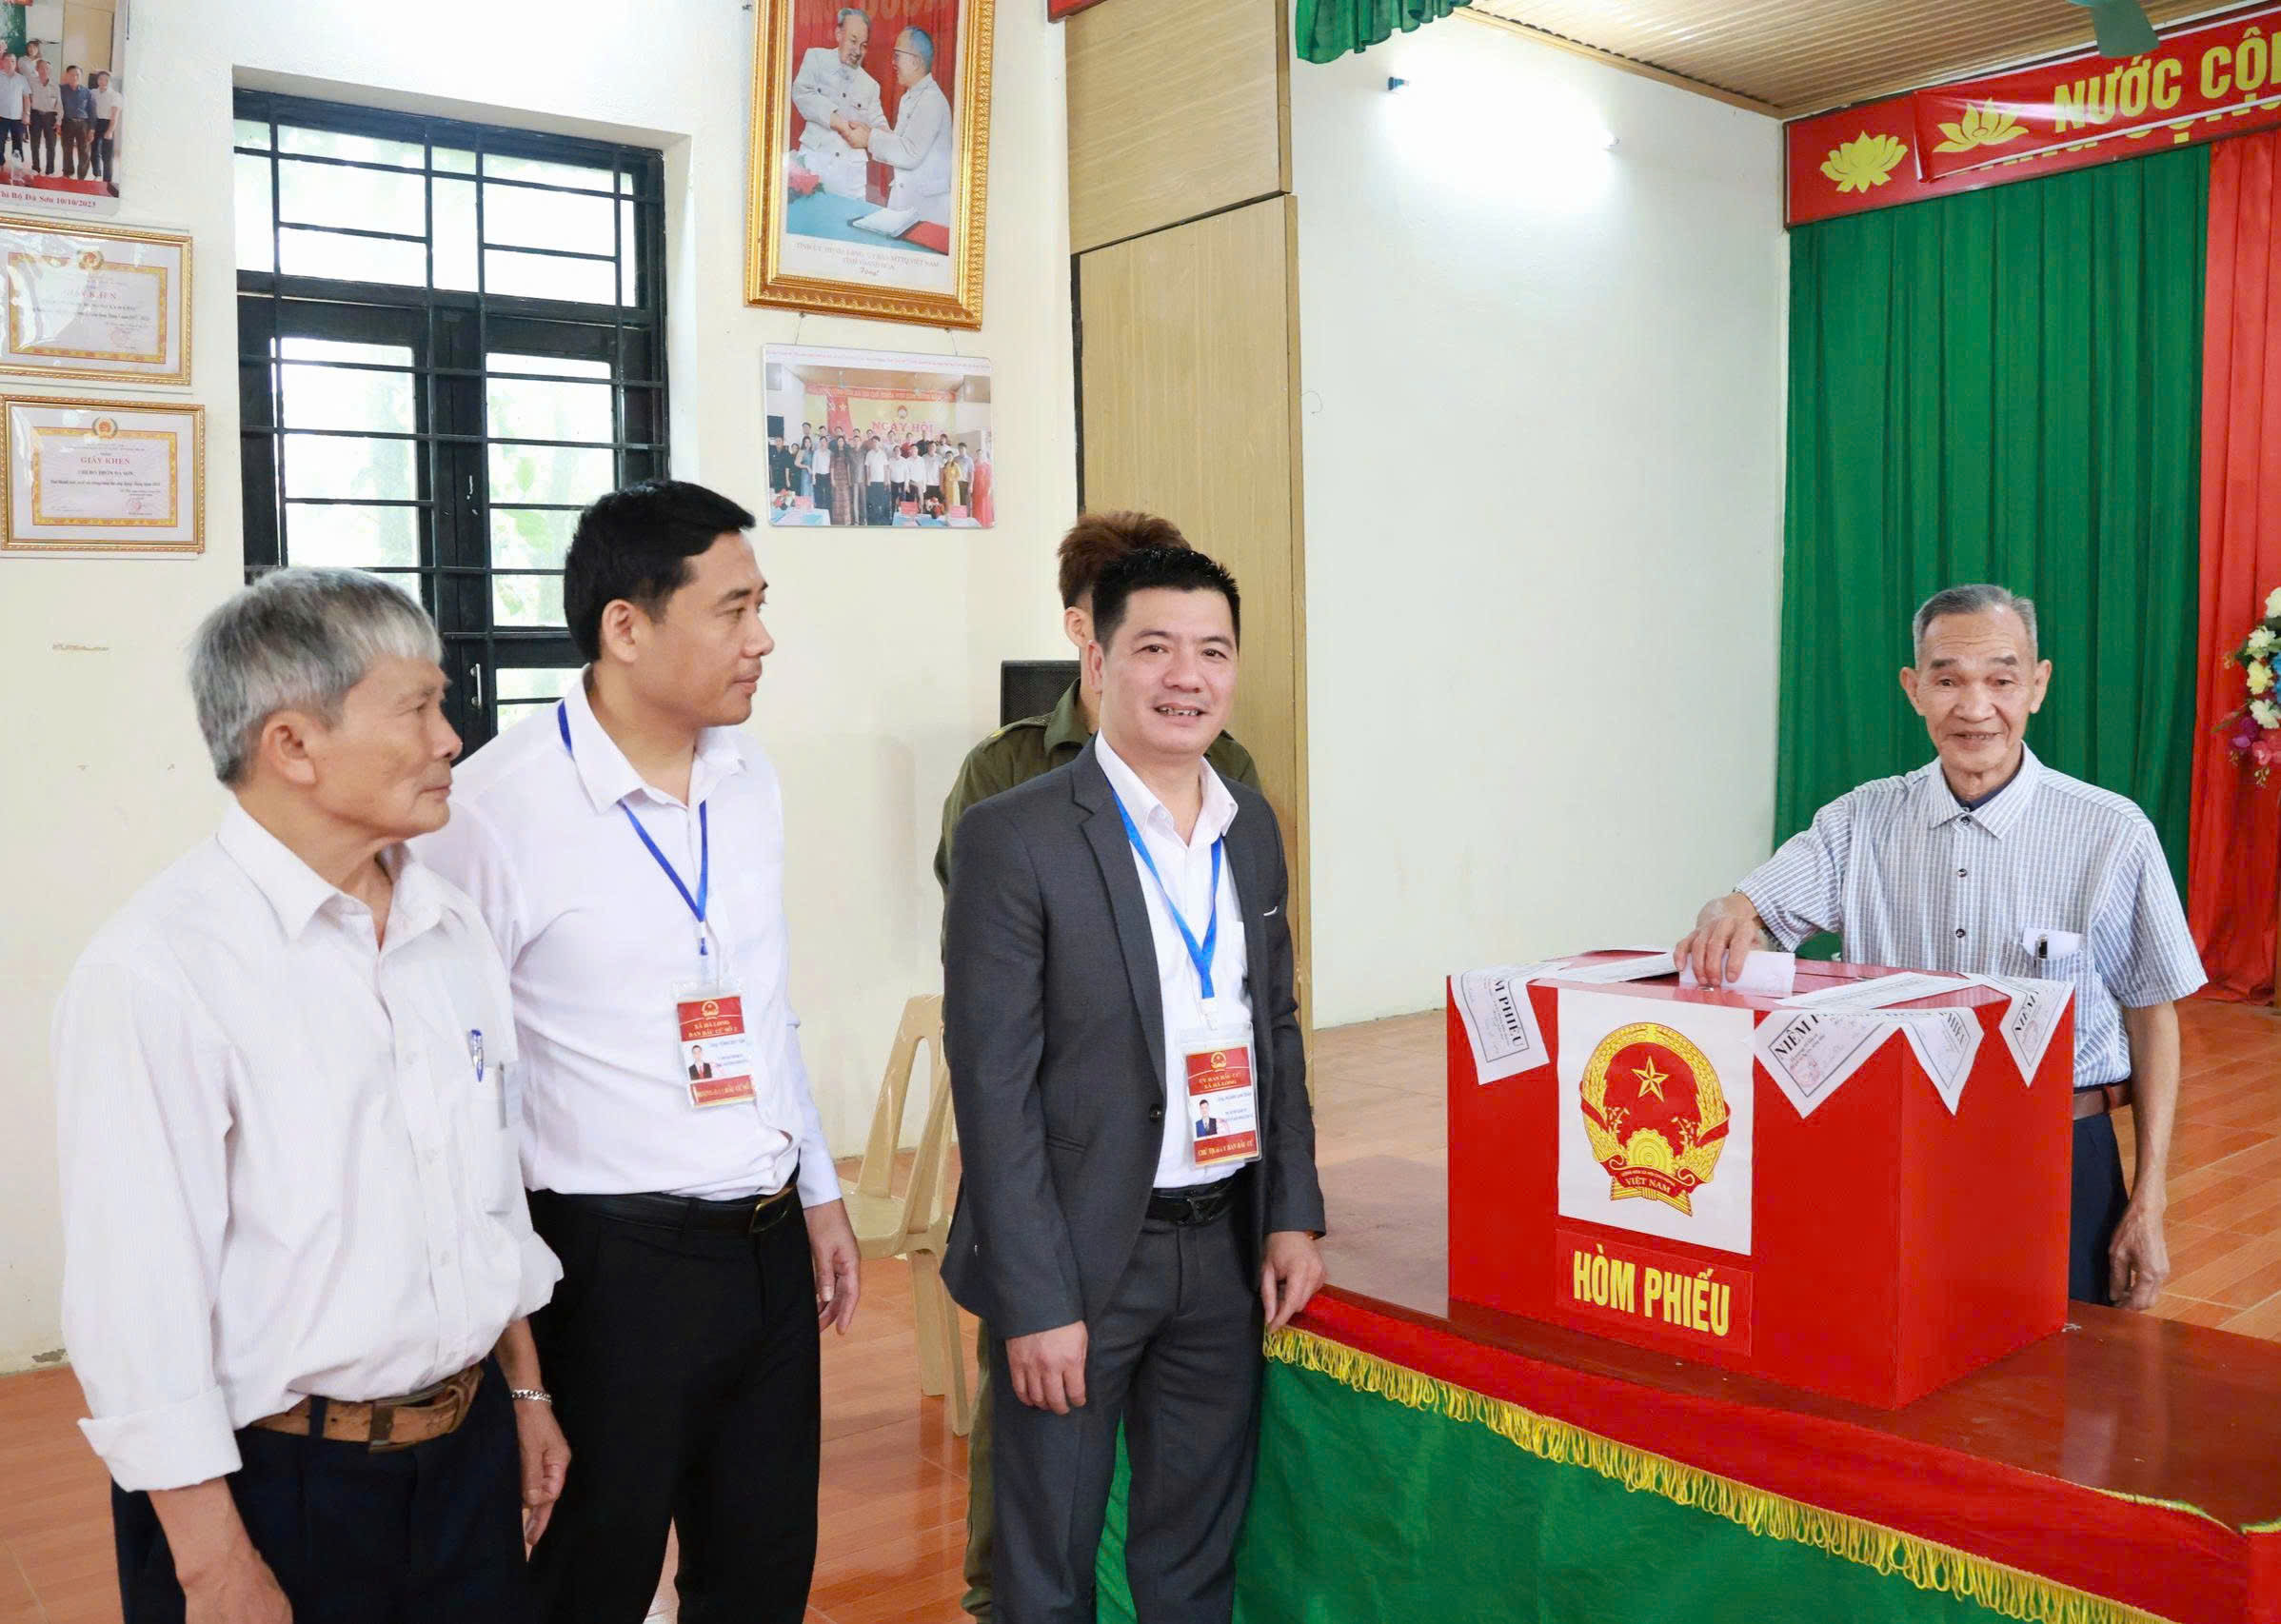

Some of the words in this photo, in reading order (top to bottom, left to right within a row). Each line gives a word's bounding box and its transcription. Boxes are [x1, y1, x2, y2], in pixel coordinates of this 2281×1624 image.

[2053, 55, 2182, 133] NƯỚC
[106, 457, 130, 465] KHEN
[1775, 1019, 1812, 1060] NIÊM
[1625, 1175, 1646, 1186] VIỆT
[1649, 1178, 1671, 1194] NAM
[1574, 1243, 1636, 1314] HÒM
[1644, 1267, 1730, 1337] PHIẾU
